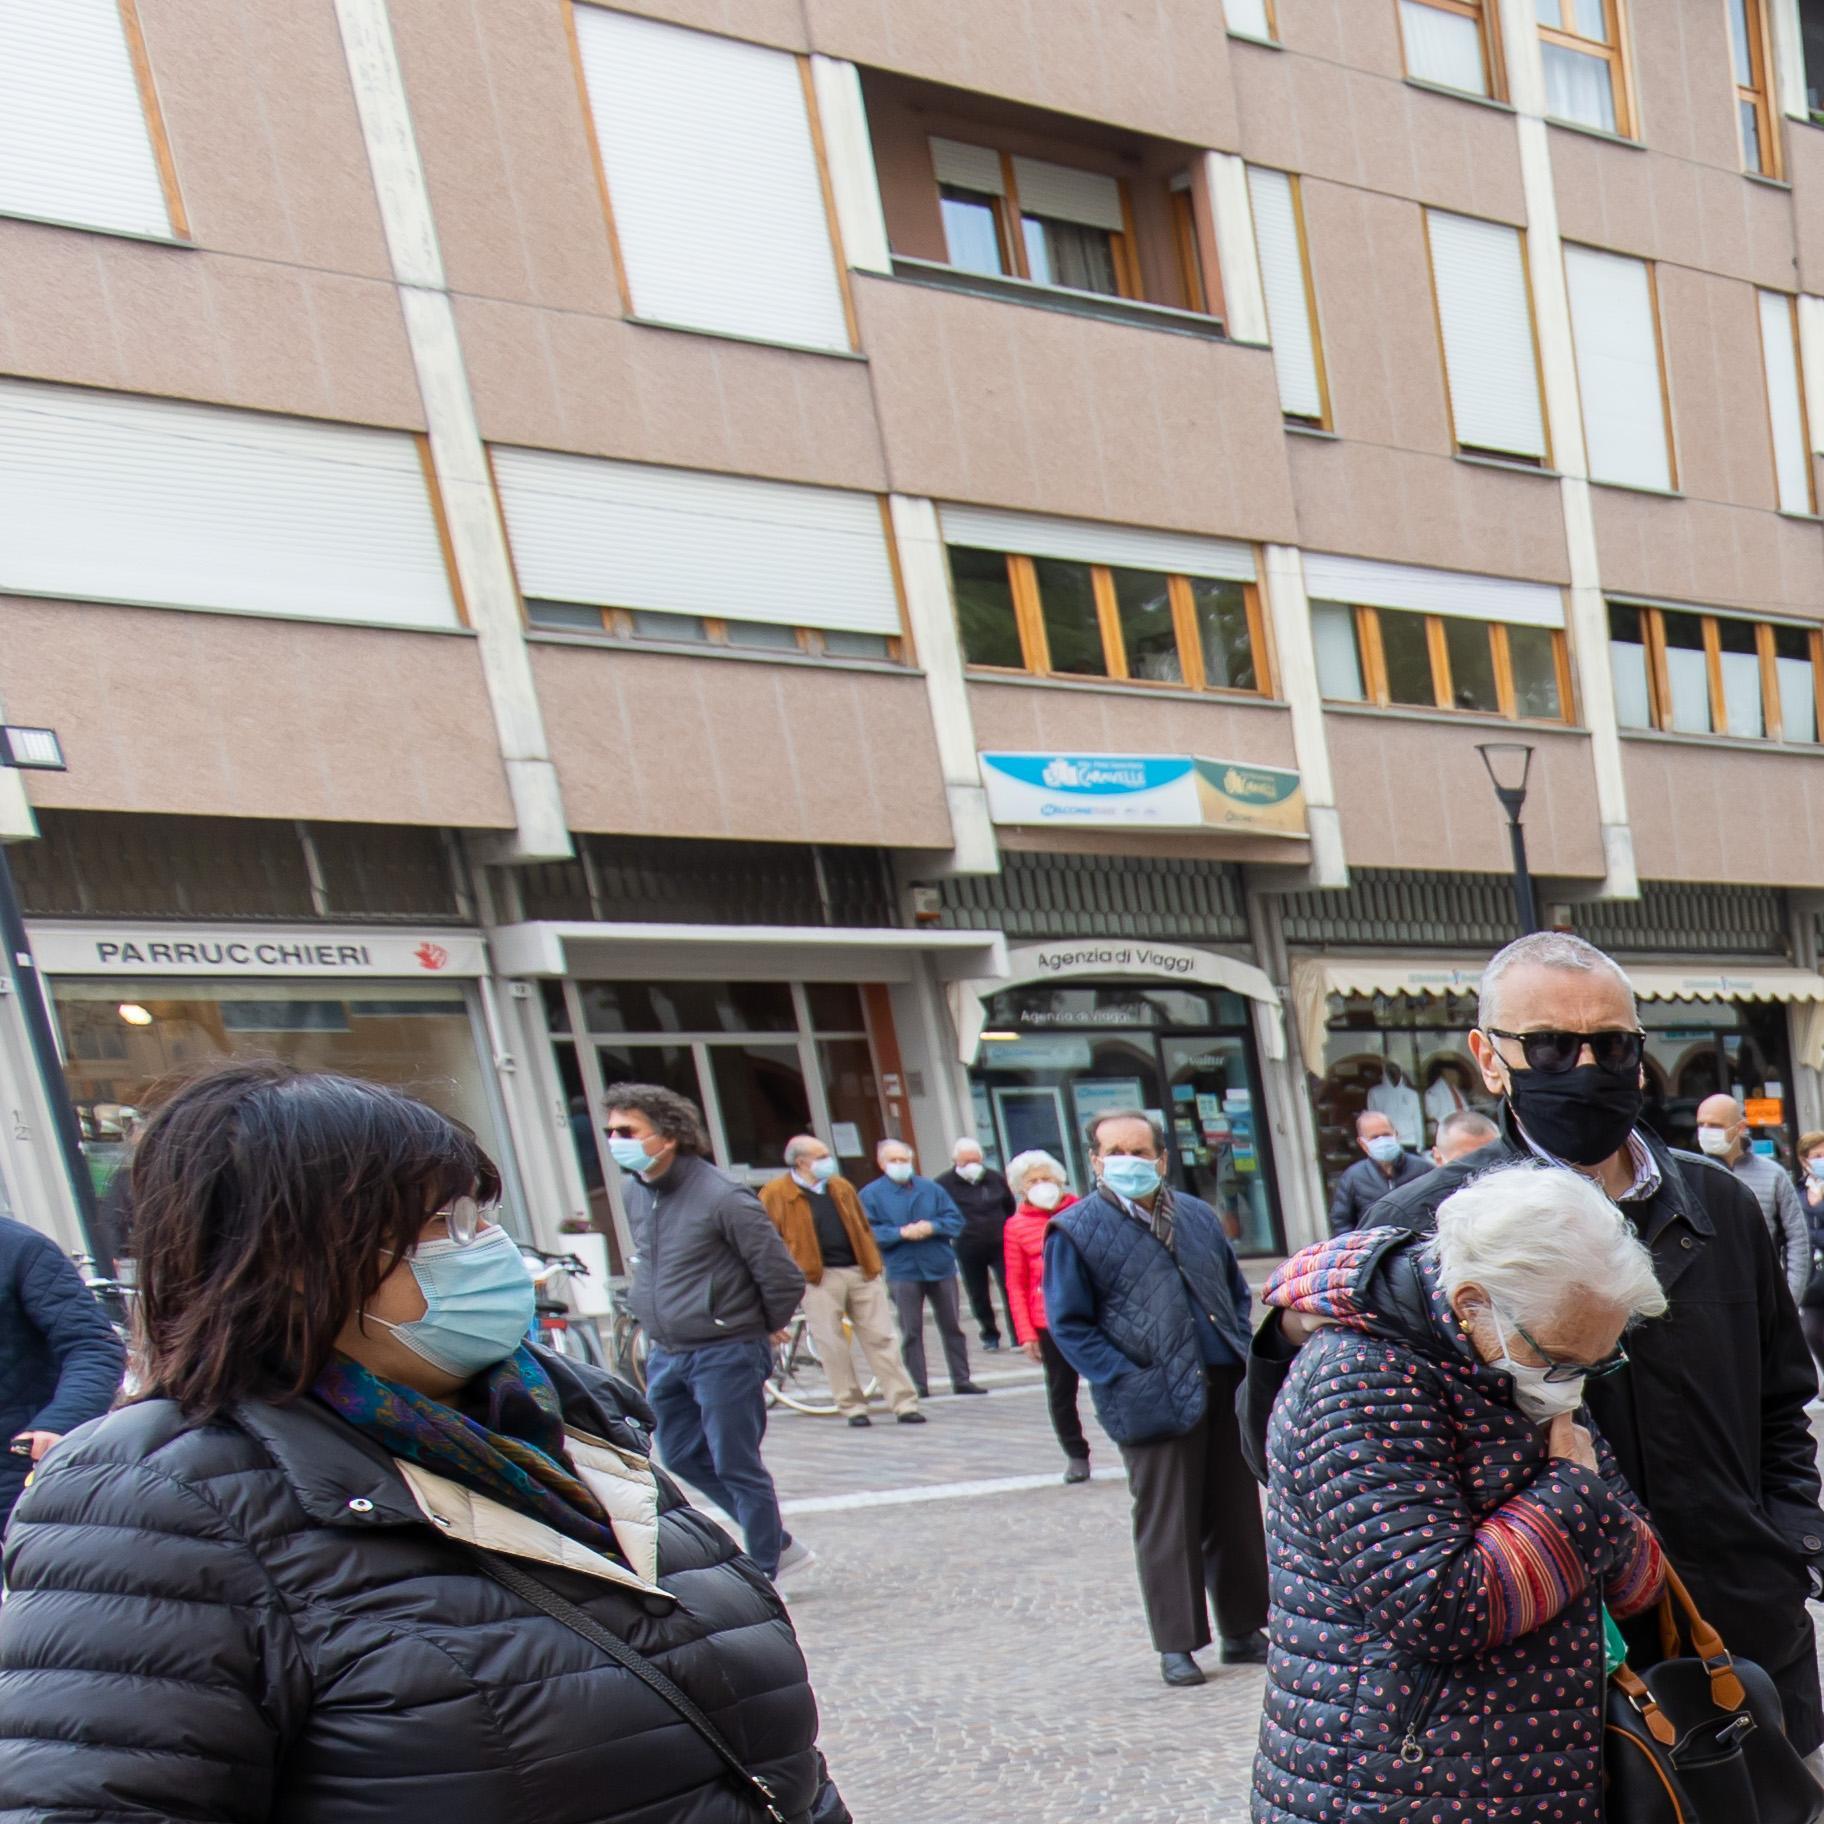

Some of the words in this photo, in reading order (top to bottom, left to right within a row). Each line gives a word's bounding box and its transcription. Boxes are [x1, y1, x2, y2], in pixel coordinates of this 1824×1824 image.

[96, 941, 372, 967] PARRUCCHIERI
[1038, 948, 1112, 972] Agenzia
[1115, 948, 1131, 963] di
[1135, 949, 1195, 971] Viaggi
[1020, 1008, 1074, 1024] Agenzia
